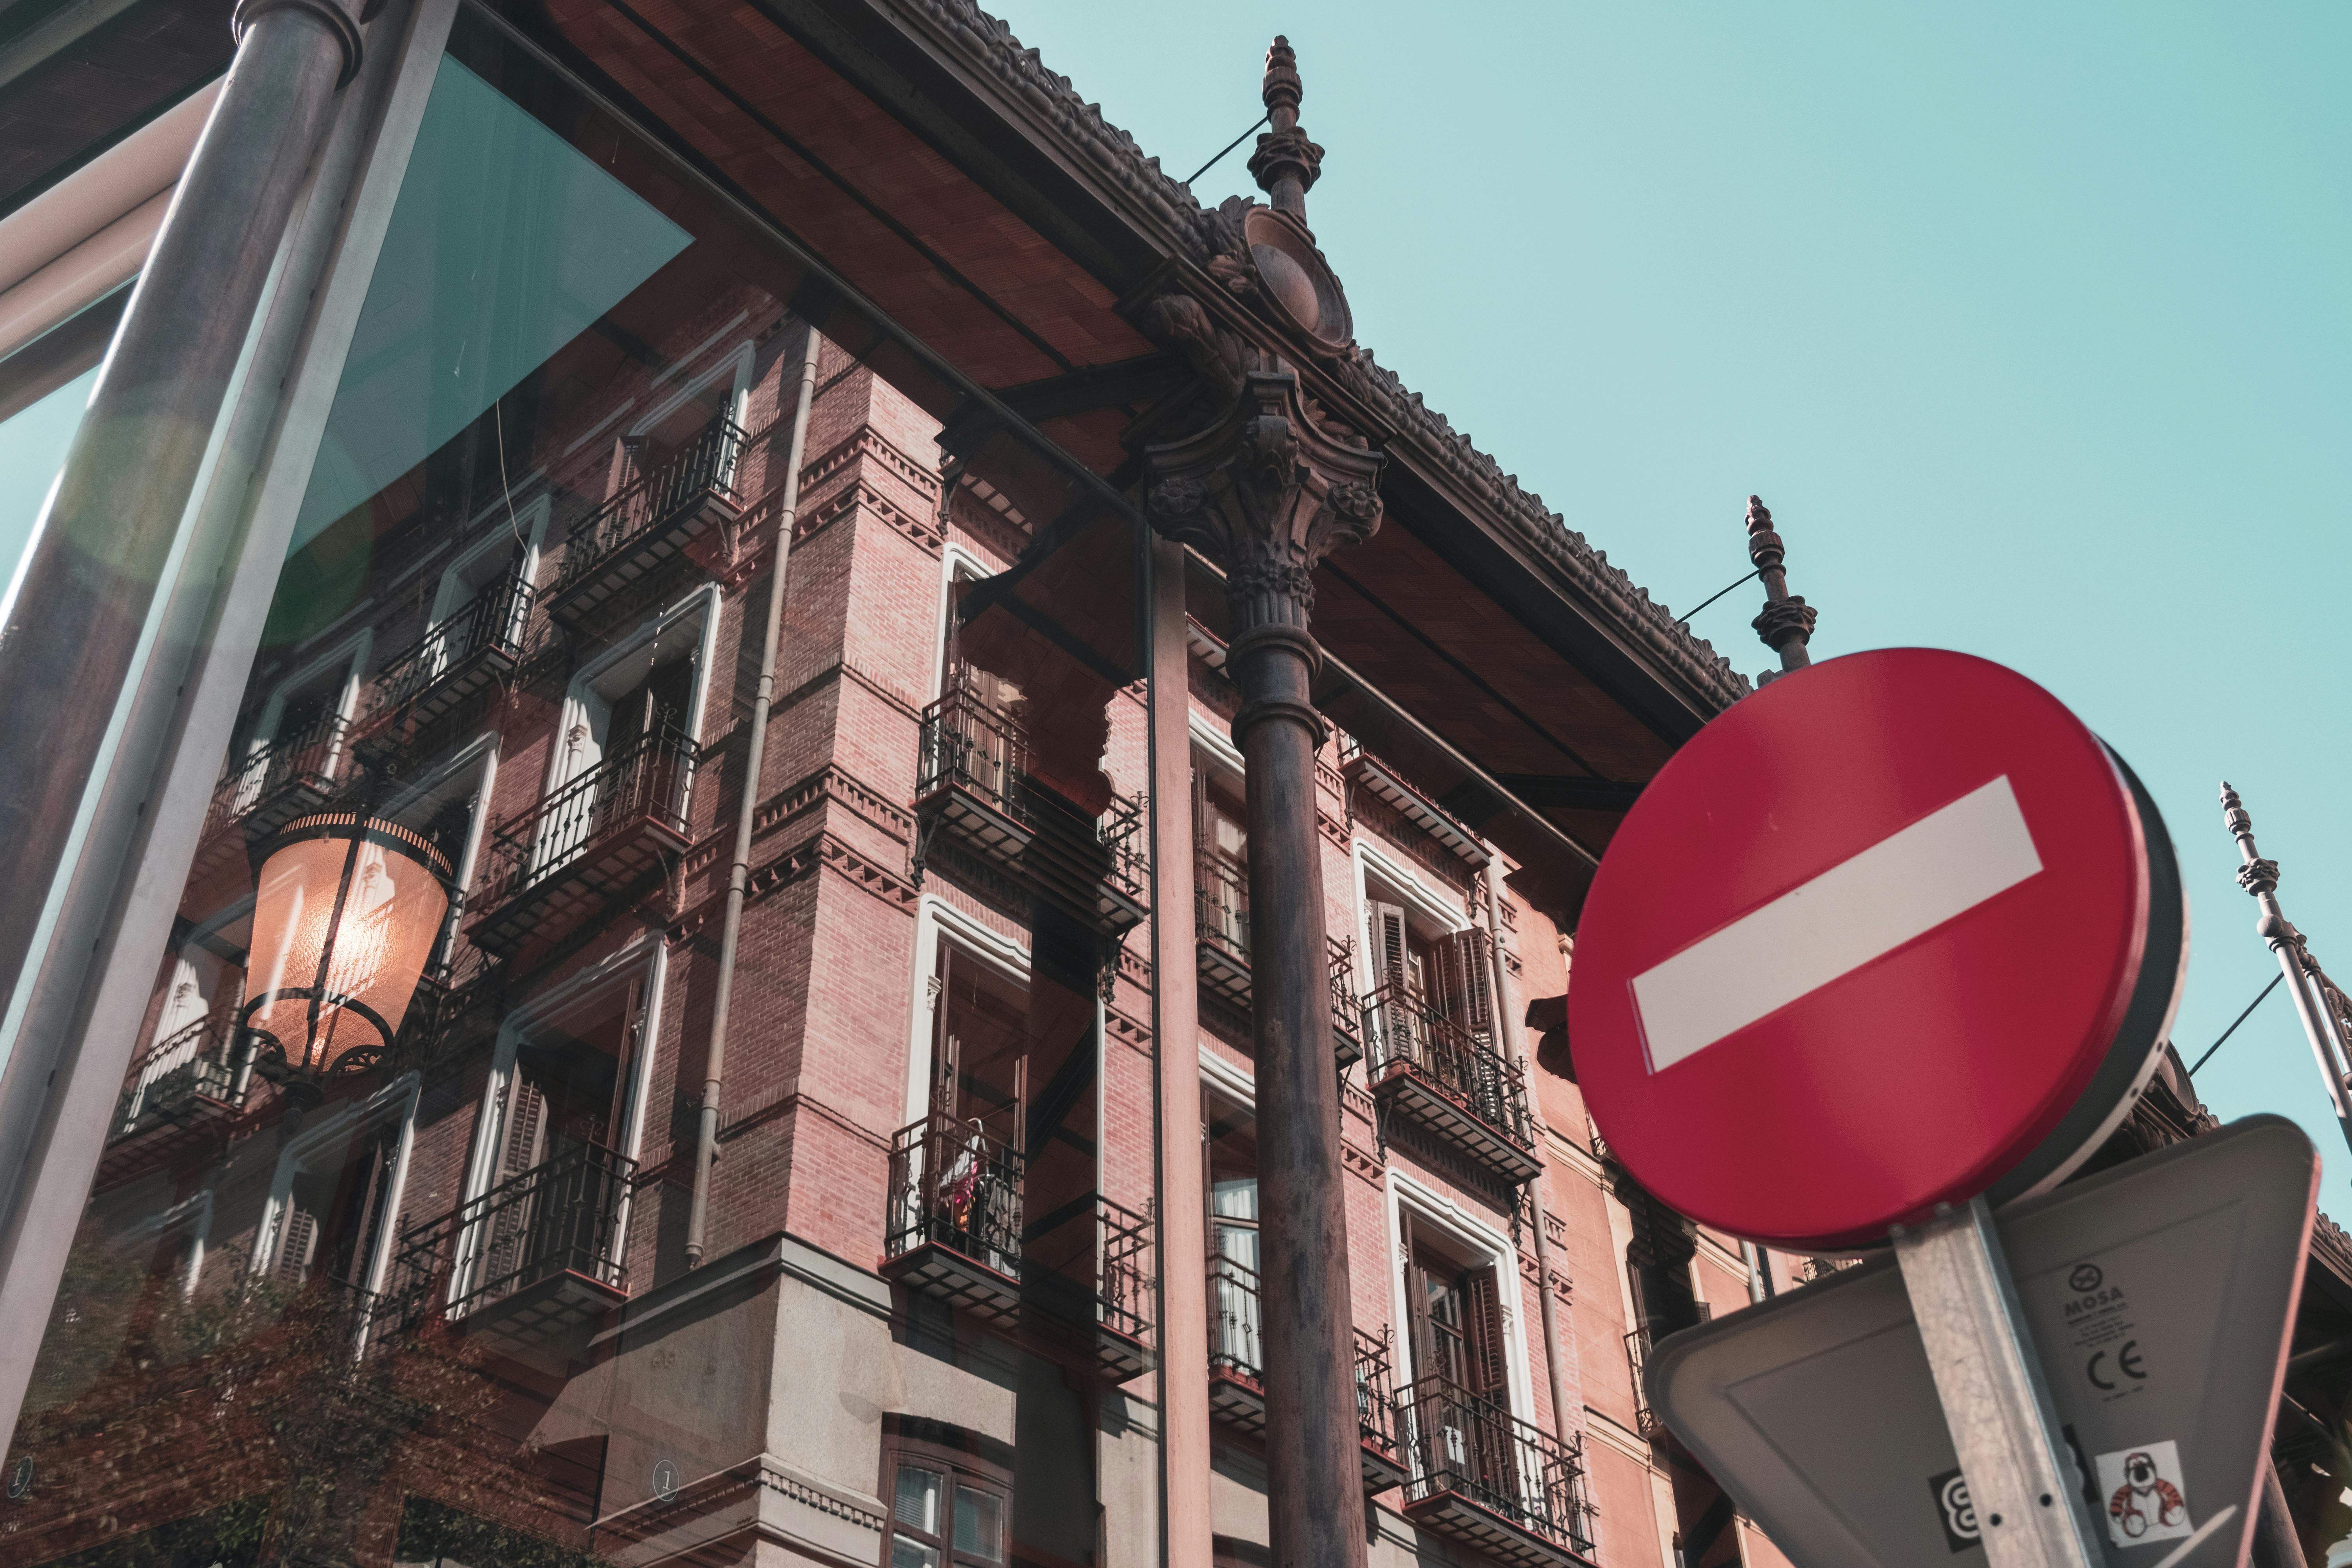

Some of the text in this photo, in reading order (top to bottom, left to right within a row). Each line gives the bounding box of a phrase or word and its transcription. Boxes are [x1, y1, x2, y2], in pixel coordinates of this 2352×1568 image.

[2065, 1287, 2124, 1317] MOSA
[2087, 1340, 2147, 1390] CE
[12, 1467, 22, 1486] 1
[662, 1471, 670, 1490] 1
